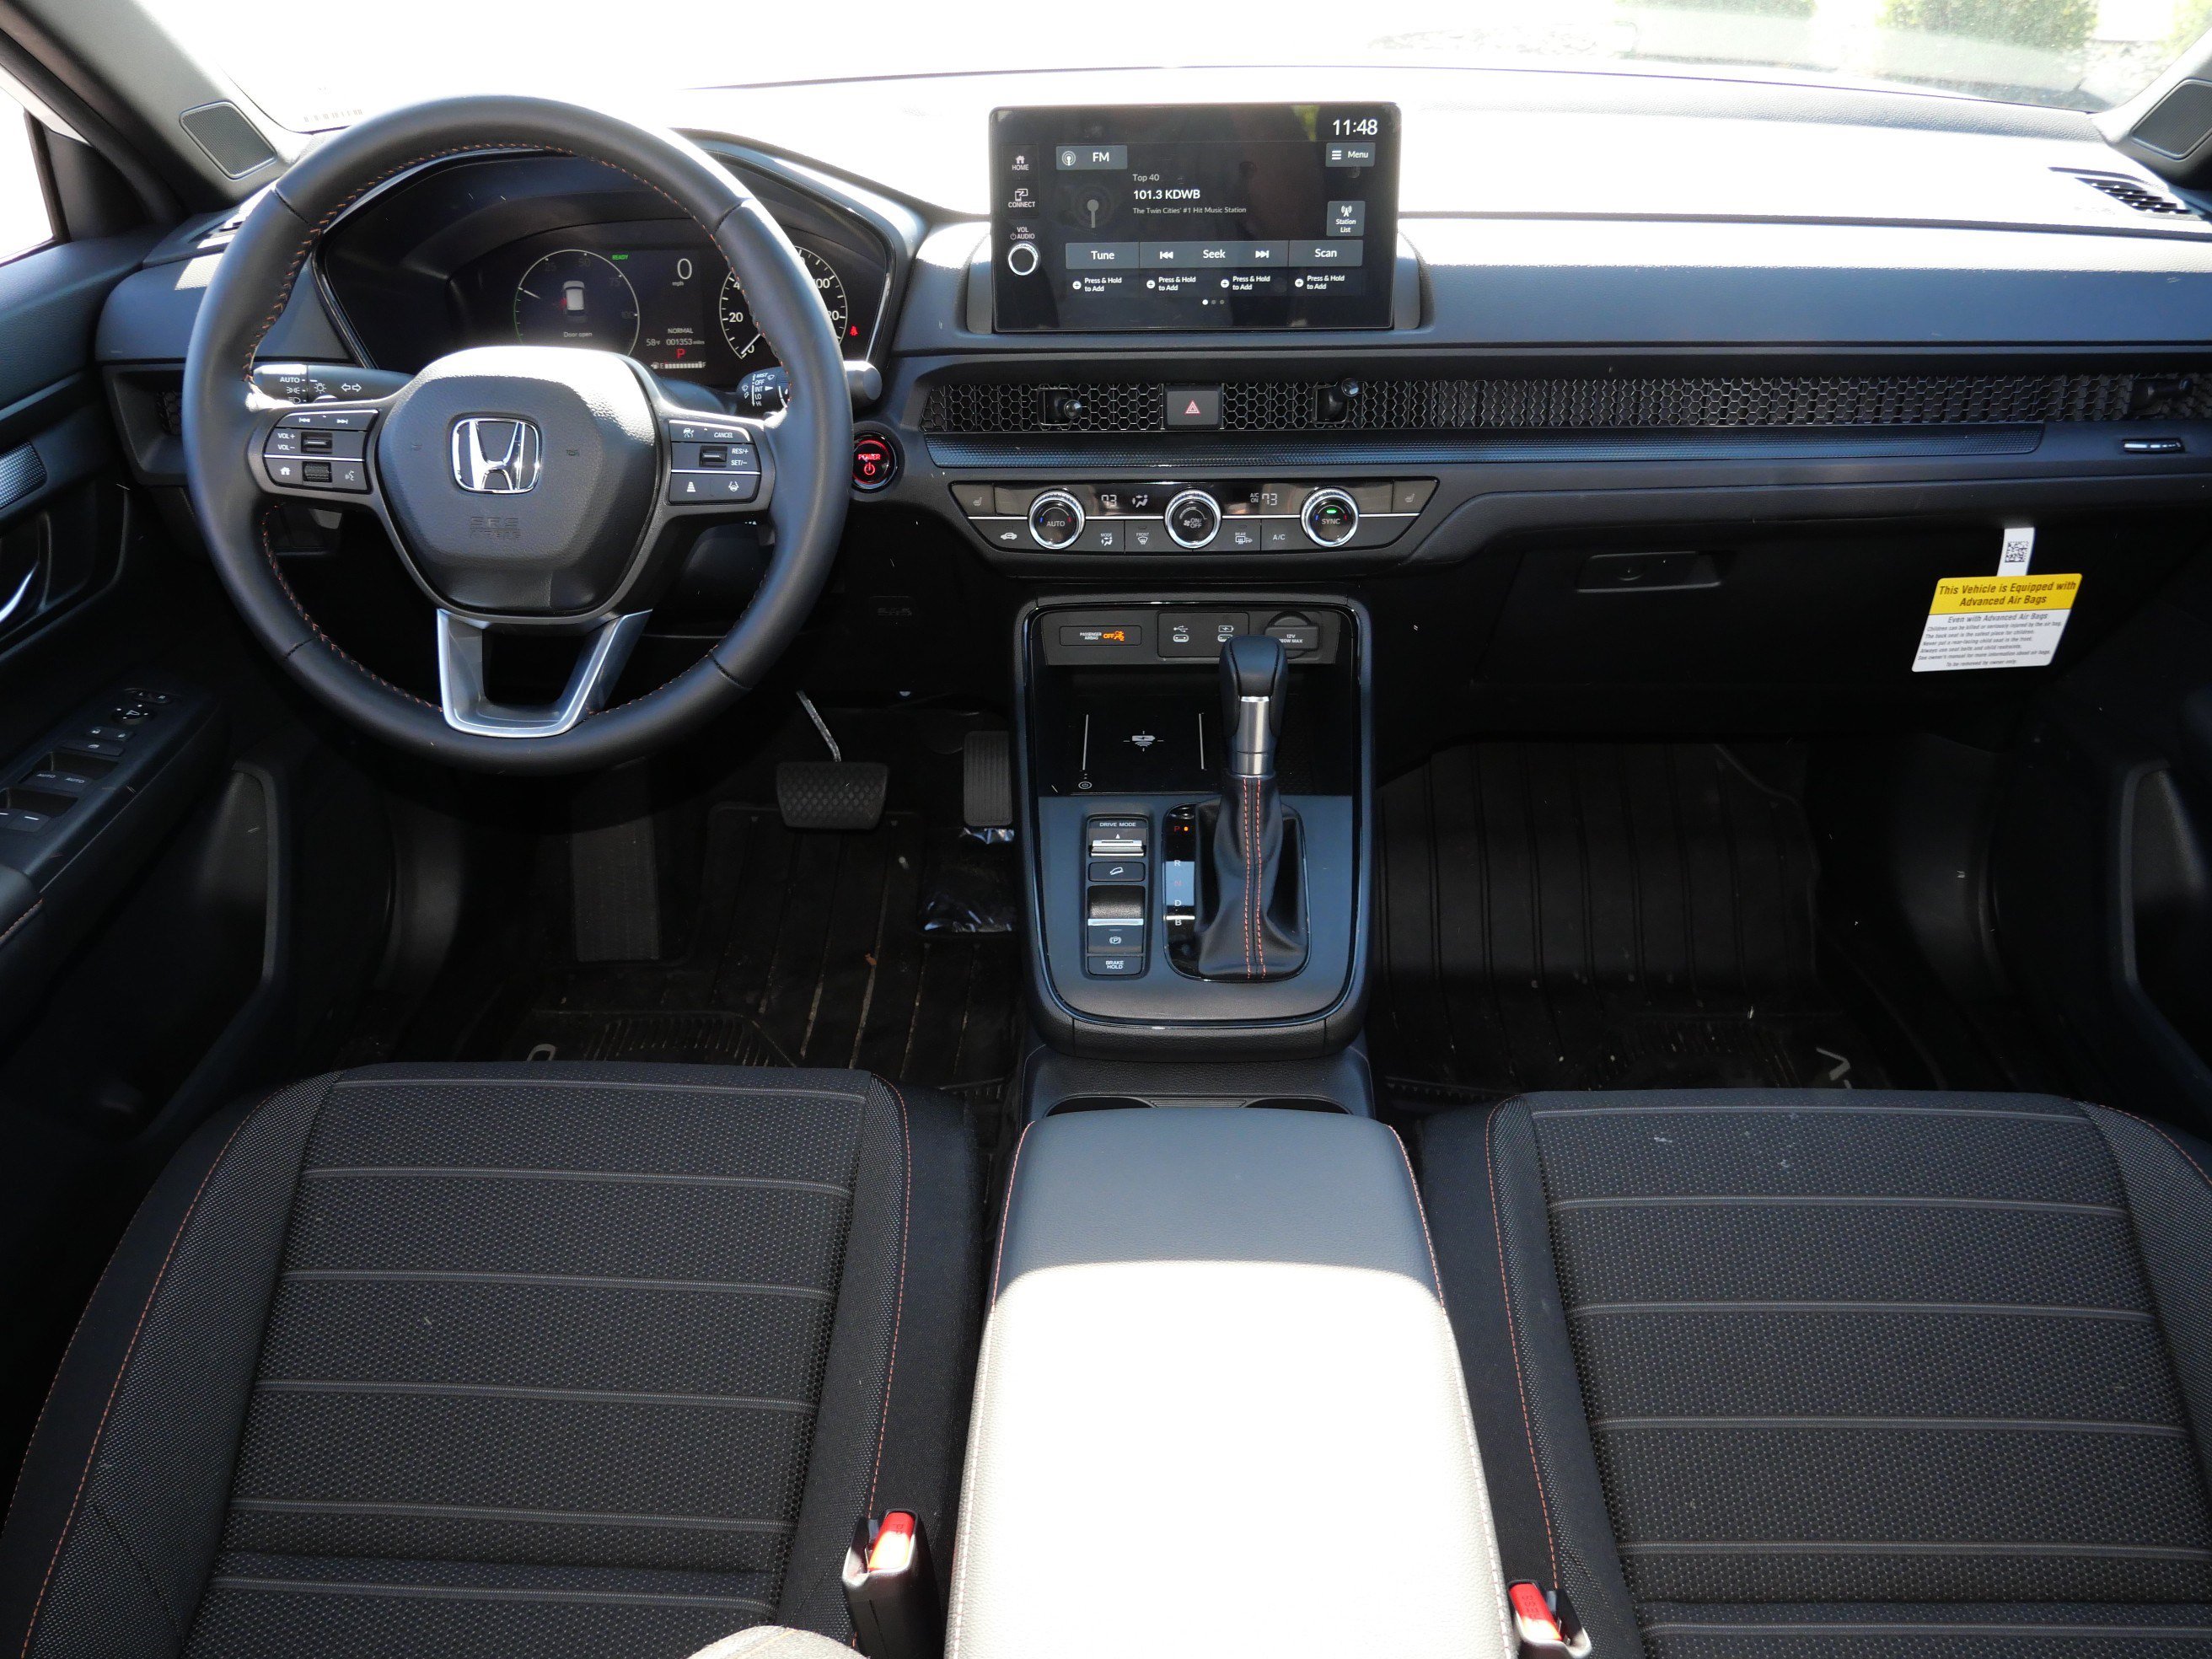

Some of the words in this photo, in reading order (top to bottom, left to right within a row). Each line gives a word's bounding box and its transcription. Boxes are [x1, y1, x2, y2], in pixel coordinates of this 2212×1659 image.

[1332, 119, 1378, 136] 11:48
[1093, 153, 1110, 163] FM
[1347, 150, 1369, 158] Menu
[1133, 174, 1147, 182] Top
[1133, 190, 1162, 200] 101.3
[1165, 189, 1200, 199] KDWB
[1091, 250, 1115, 260] Tune
[1203, 250, 1226, 259] Seek
[1315, 249, 1338, 258] Scan
[677, 258, 693, 280] 0
[728, 312, 744, 322] 20
[676, 348, 686, 359] P
[1940, 586, 1959, 595] This
[1962, 583, 1996, 593] Vehicle
[2000, 583, 2007, 593] is
[2010, 582, 2054, 593] Equipped
[2056, 581, 2075, 590] with
[1959, 596, 2005, 607] Advanced
[2007, 595, 2021, 604] Air
[2023, 595, 2047, 605] Bags
